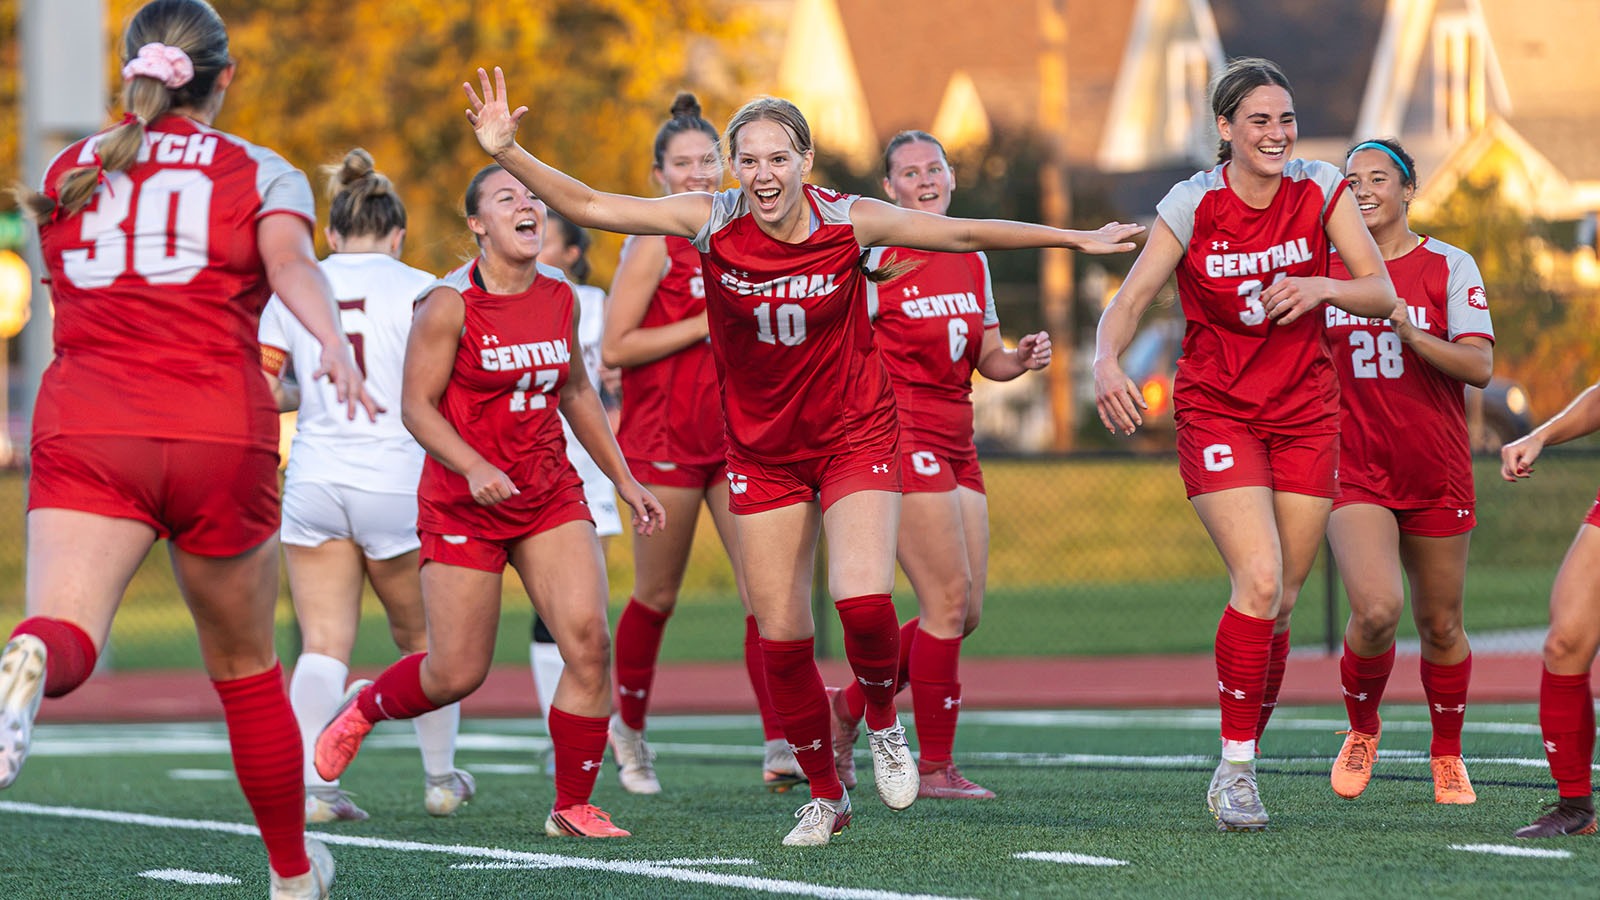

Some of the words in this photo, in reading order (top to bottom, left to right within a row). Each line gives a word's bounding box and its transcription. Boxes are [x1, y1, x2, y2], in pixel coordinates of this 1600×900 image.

[77, 131, 219, 166] TCH
[61, 168, 214, 289] 30
[1205, 237, 1313, 278] CENTRAL
[720, 272, 840, 300] CENTRAL
[901, 291, 983, 319] CENTRA
[1237, 271, 1288, 326] 3
[753, 301, 807, 346] 10
[1325, 304, 1431, 330] CEAL
[947, 317, 969, 363] 6
[1348, 330, 1405, 379] 28
[509, 368, 559, 412] 17
[911, 450, 941, 476] C
[1203, 443, 1235, 472] C
